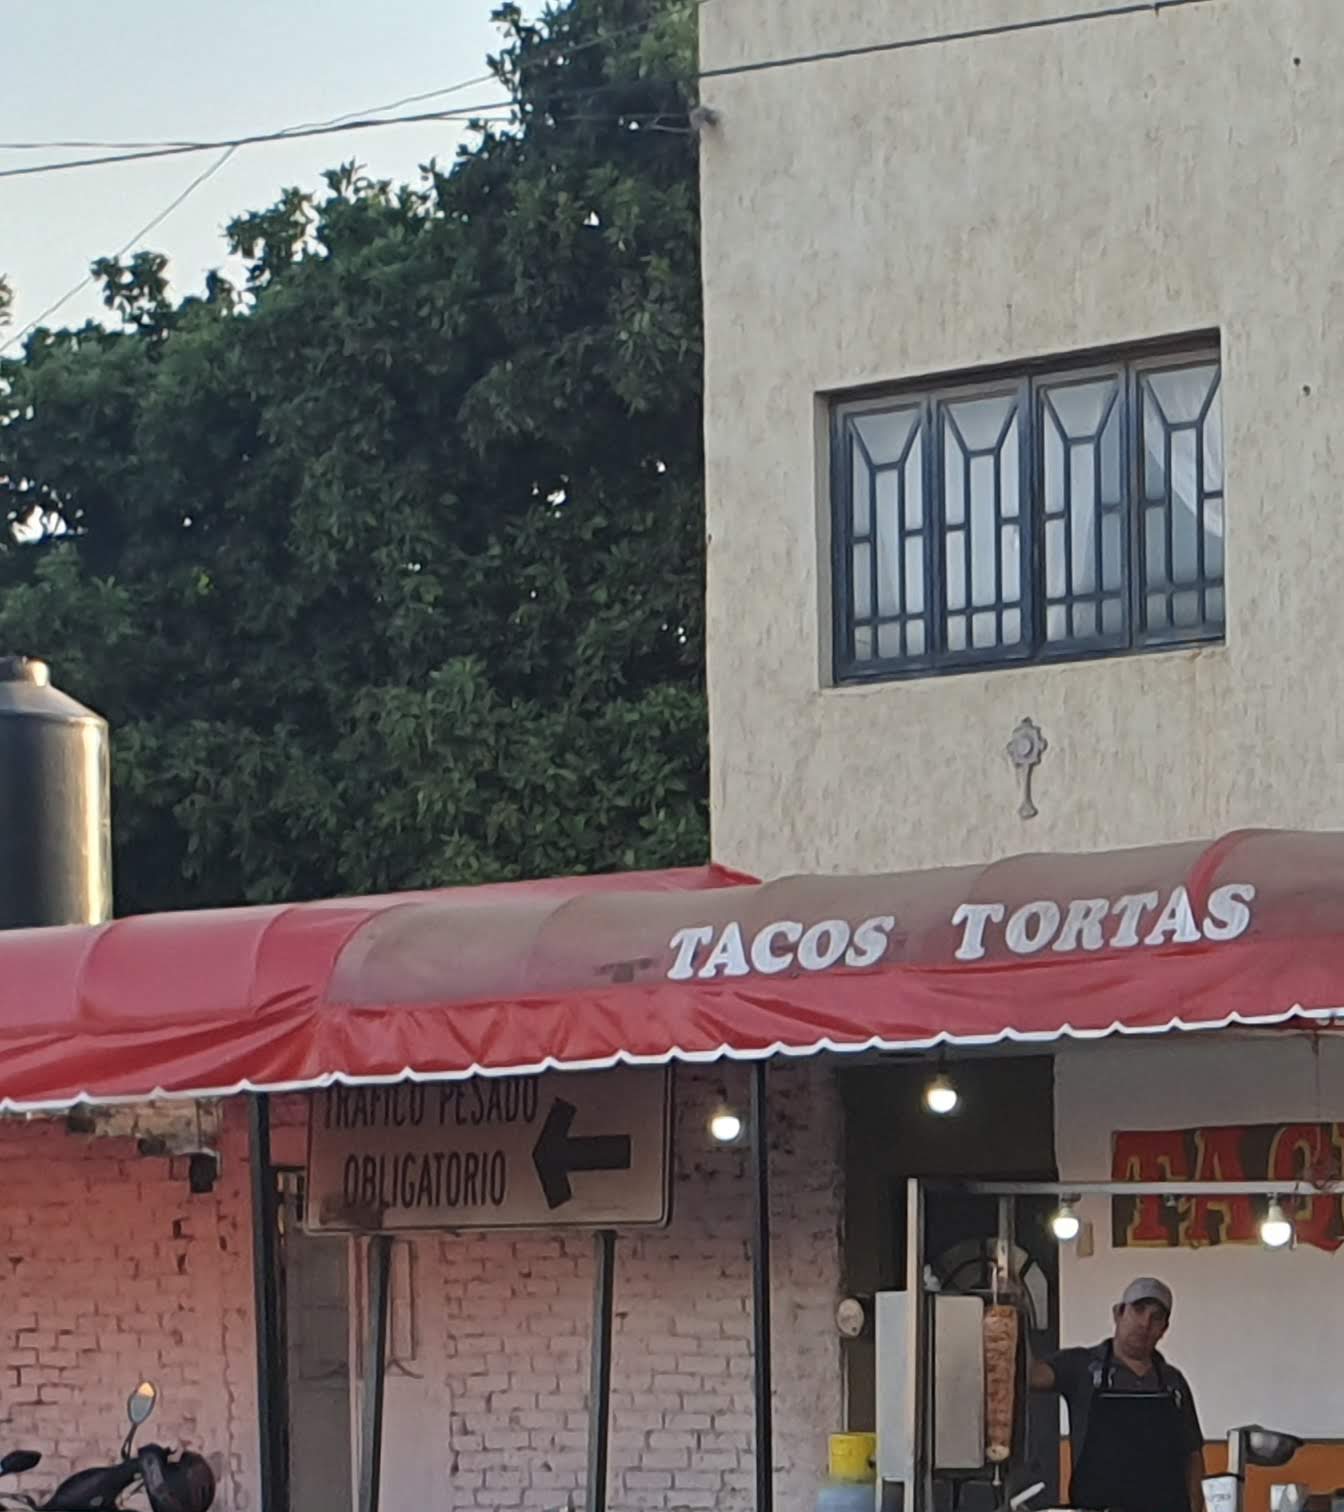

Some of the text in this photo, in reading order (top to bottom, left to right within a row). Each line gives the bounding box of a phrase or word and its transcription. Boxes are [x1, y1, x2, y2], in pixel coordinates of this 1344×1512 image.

[667, 915, 895, 981] TACOS
[951, 883, 1256, 960] TORTAS
[438, 1076, 539, 1126] PESADO
[343, 1149, 507, 1209] OBLIGATORIO
